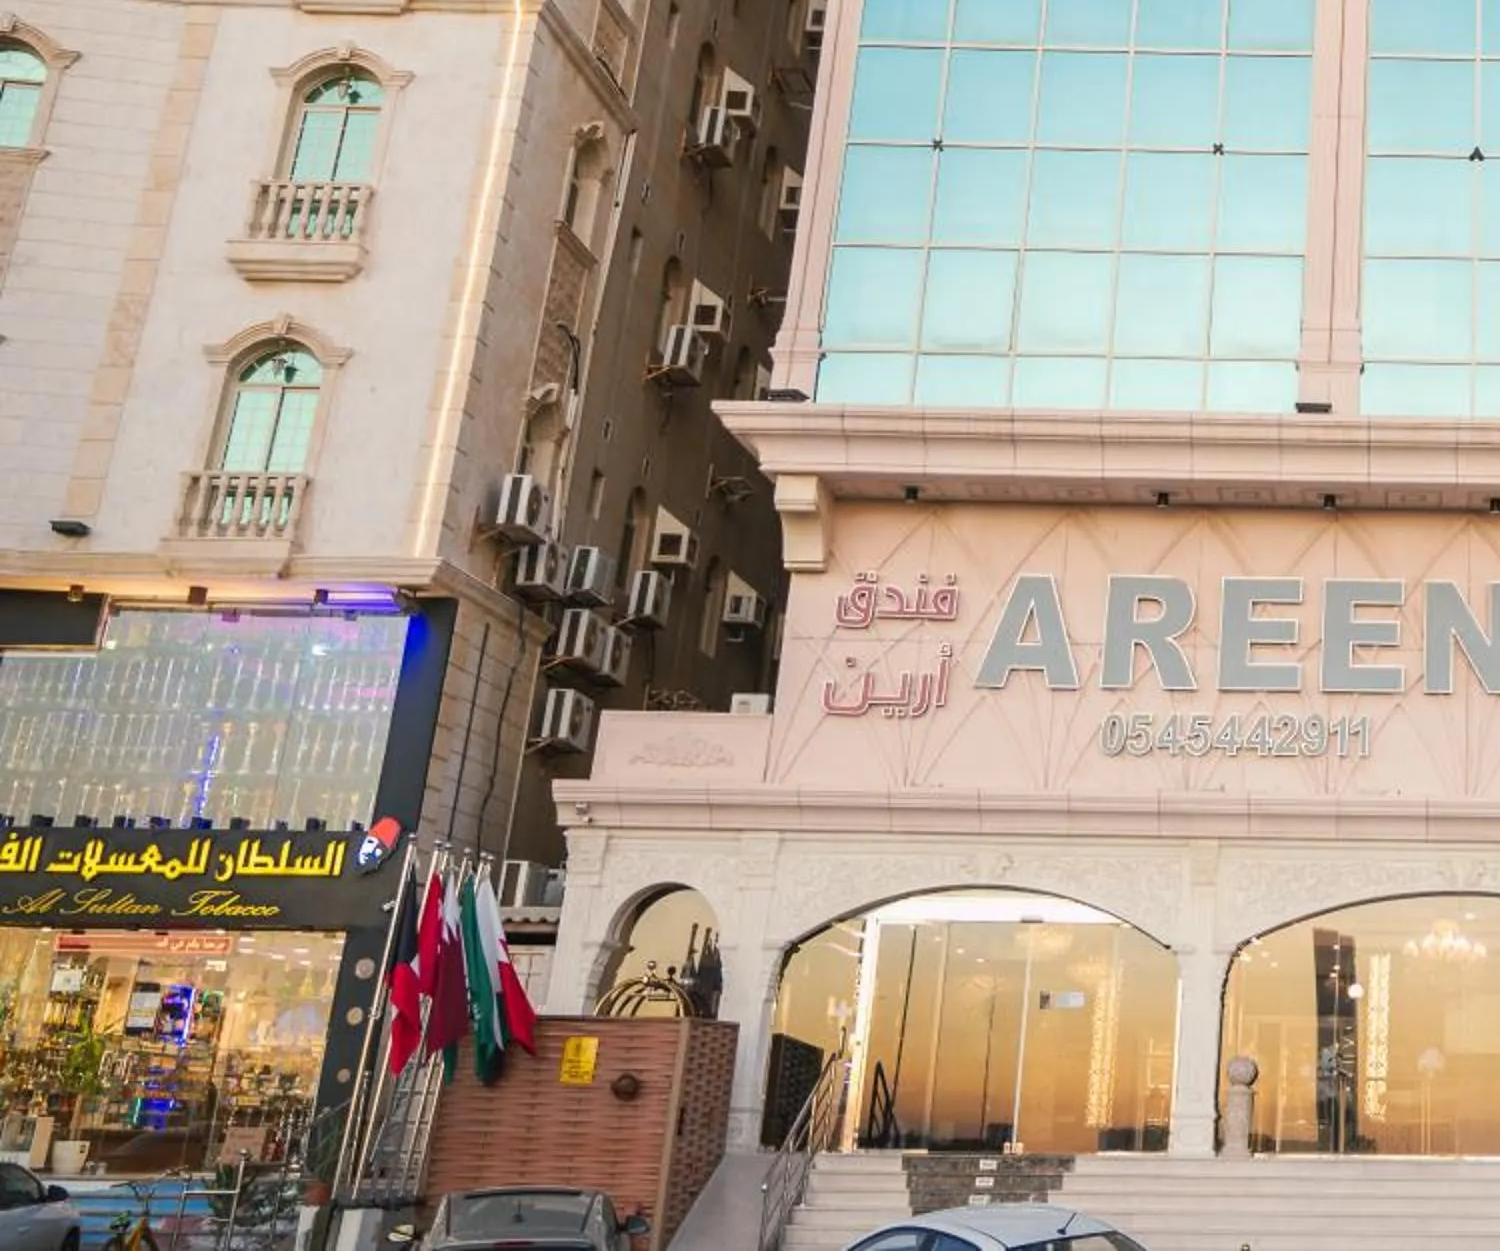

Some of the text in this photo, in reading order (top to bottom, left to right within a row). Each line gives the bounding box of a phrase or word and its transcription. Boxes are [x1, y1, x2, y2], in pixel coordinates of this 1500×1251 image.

[835, 572, 959, 629] فندق
[823, 642, 954, 718] أرين
[1100, 713, 1372, 757] 0545442911
[45, 836, 213, 882] للمعسلات
[215, 838, 348, 882] السلطان
[2, 888, 281, 917] Al Sultan Tobacco
